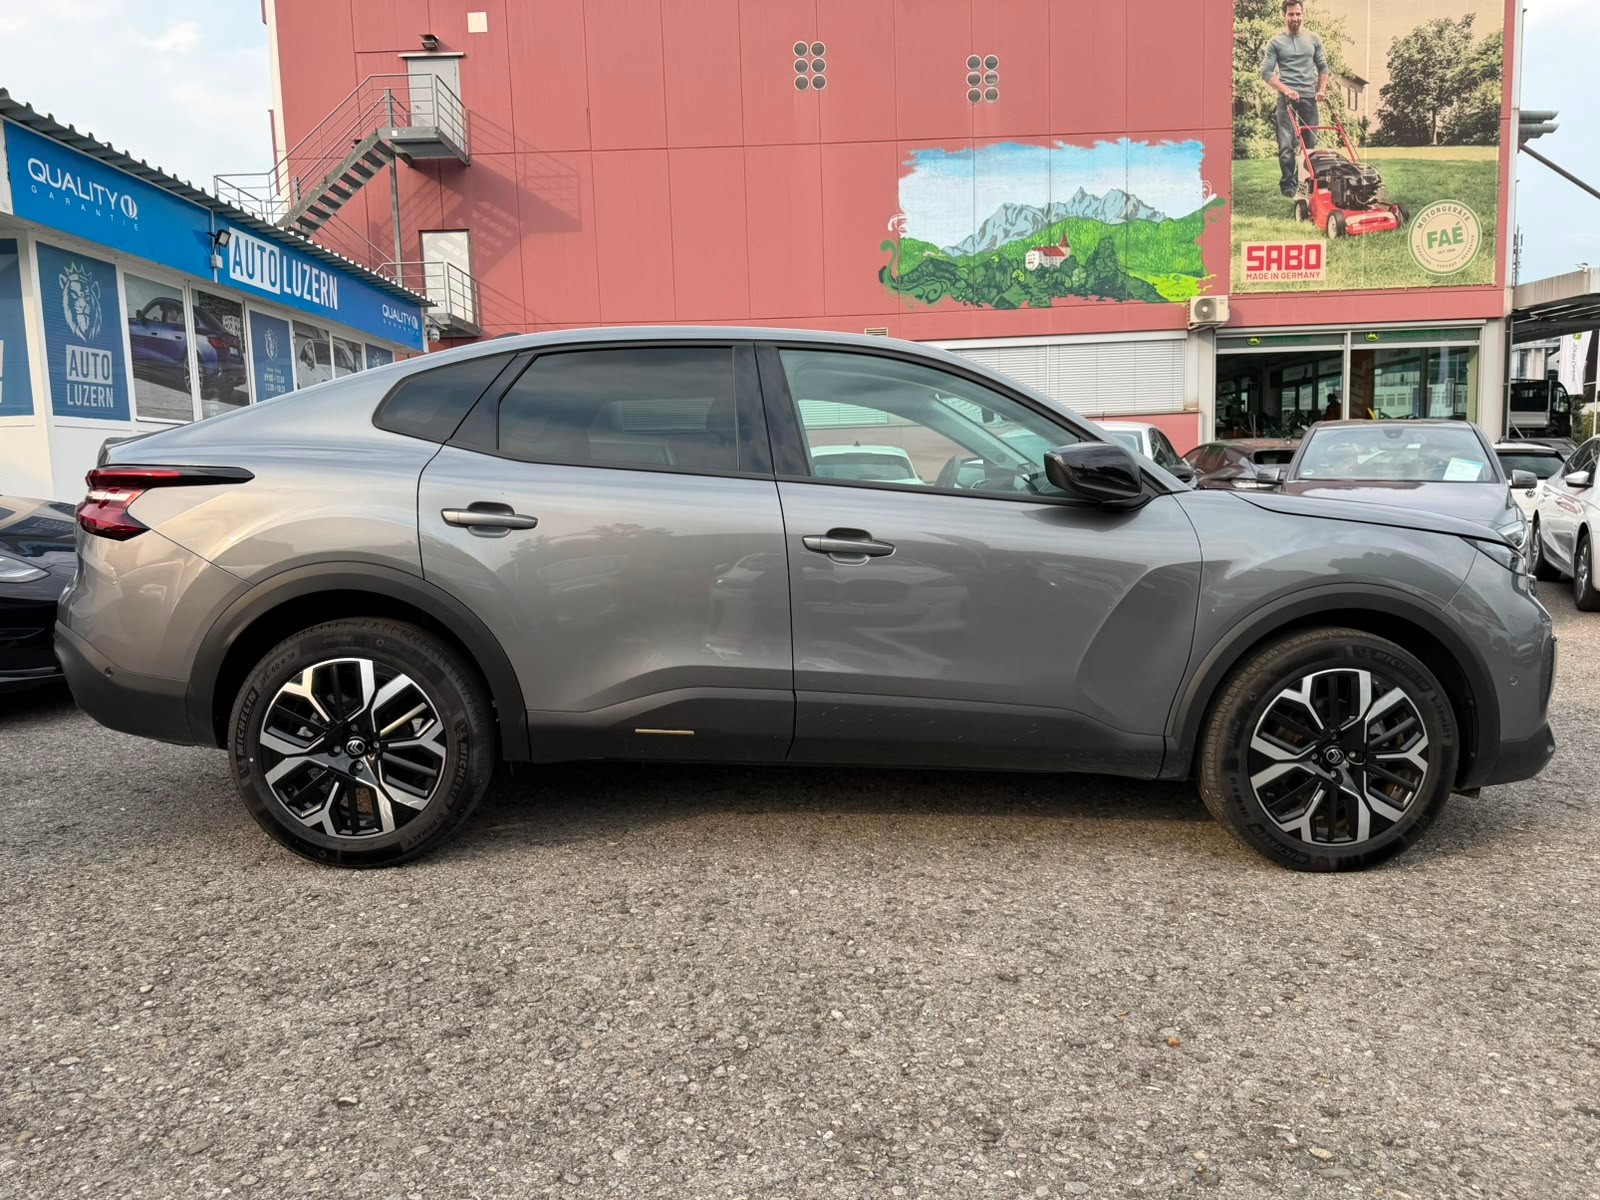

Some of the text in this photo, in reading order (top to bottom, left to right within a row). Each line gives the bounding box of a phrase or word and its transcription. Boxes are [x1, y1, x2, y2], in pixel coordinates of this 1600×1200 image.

[27, 157, 118, 210] QUALITY
[31, 185, 139, 231] GARANTIE
[232, 236, 339, 311] AUTO LUZERN
[1246, 243, 1322, 272] SABO
[1246, 271, 1321, 281] MADE IN GERMANY
[381, 303, 412, 326] QUALITY
[69, 349, 111, 381] AUTO
[66, 383, 114, 409] LUZERN
[236, 688, 258, 757] MICHELIN
